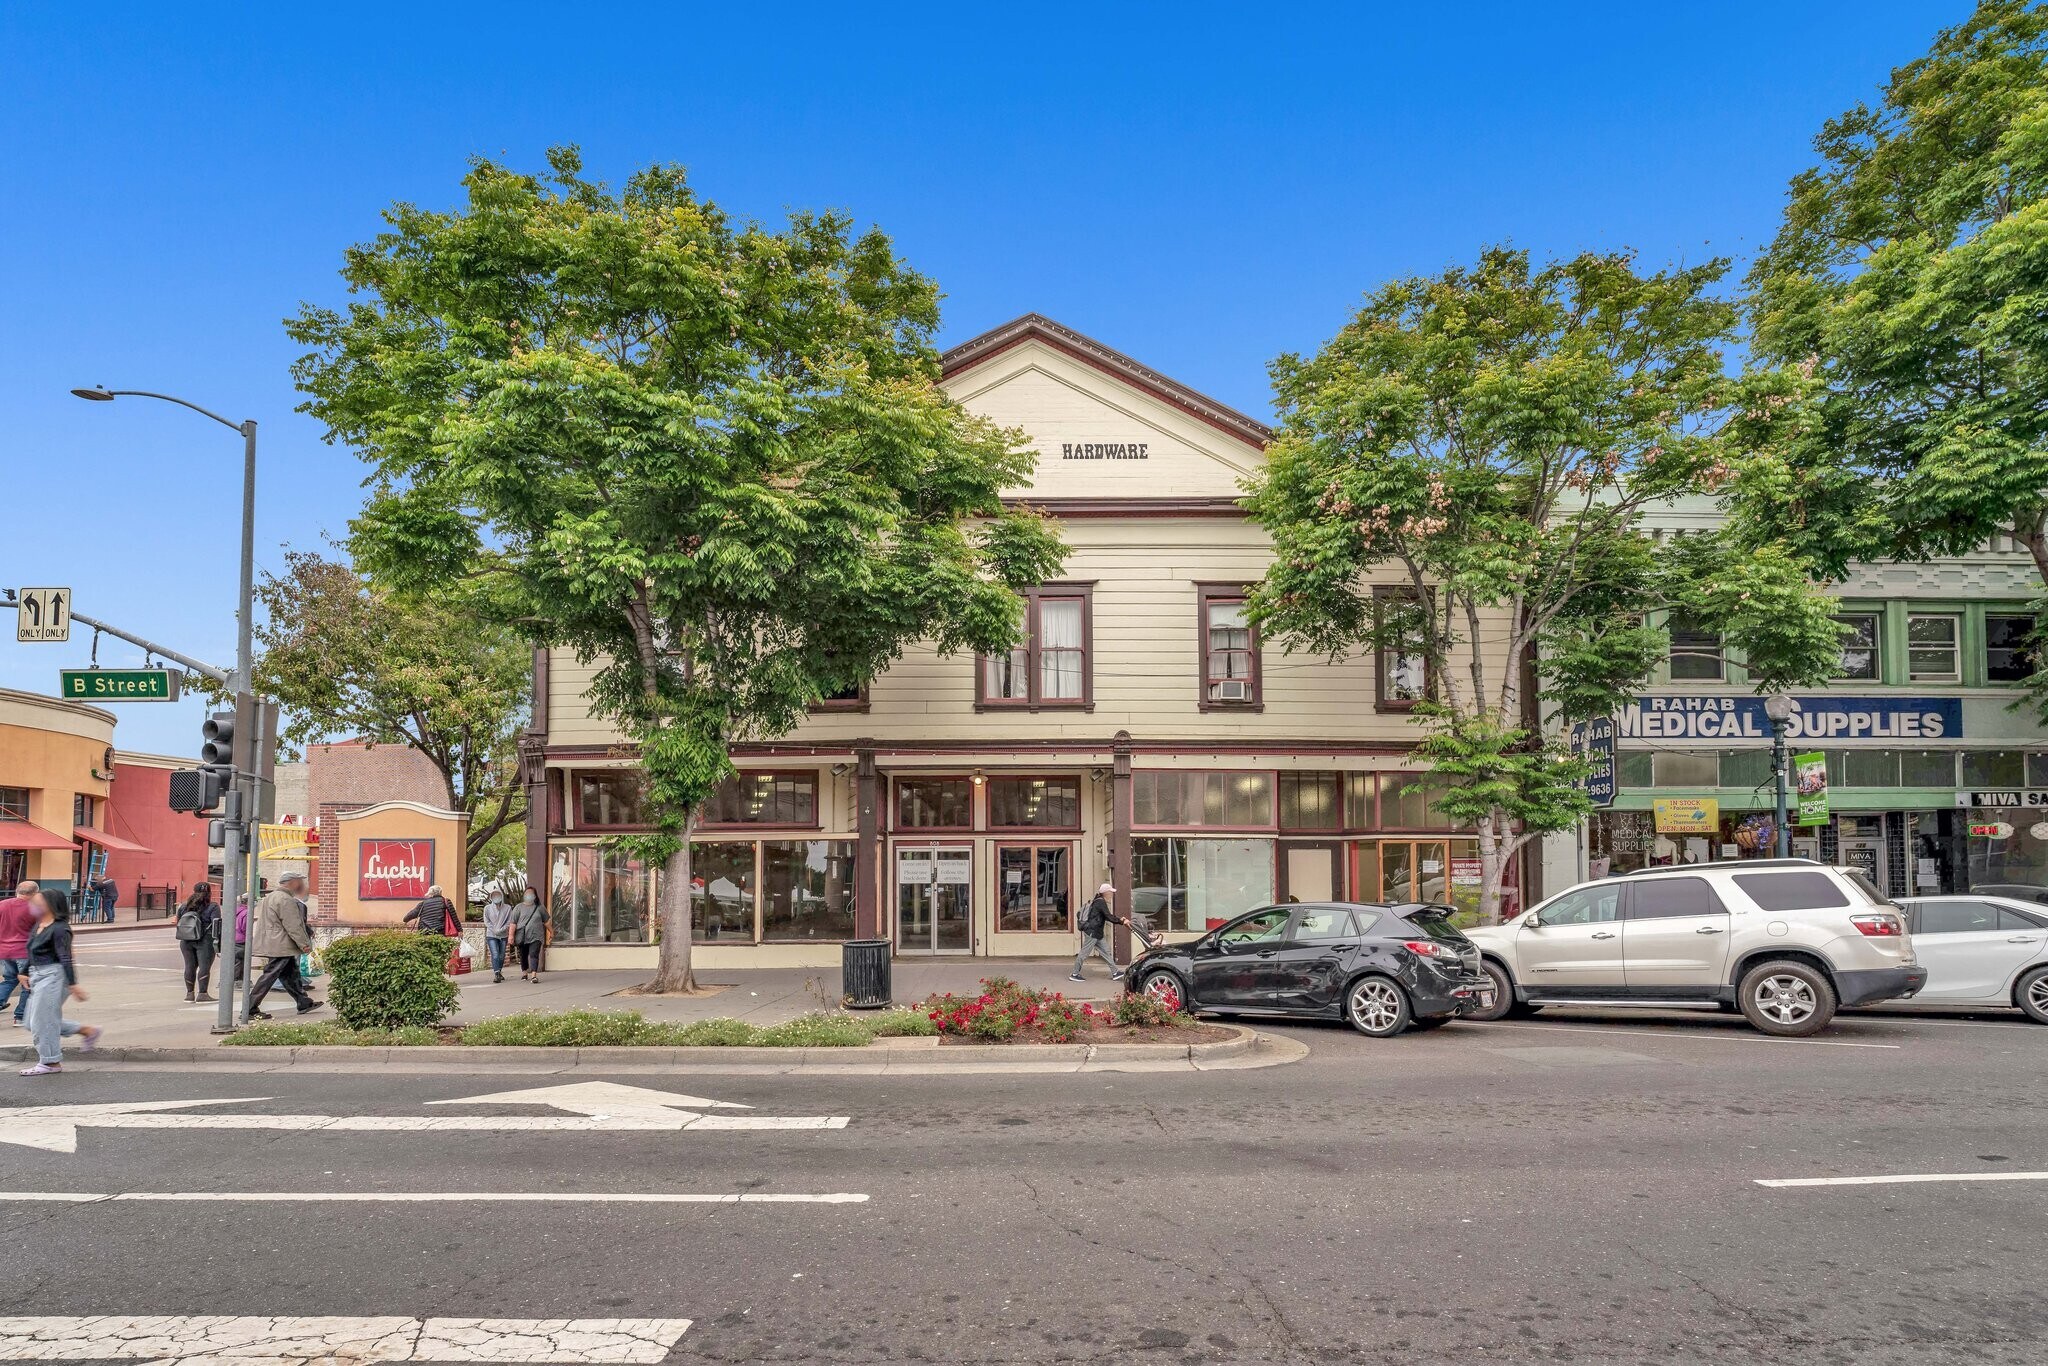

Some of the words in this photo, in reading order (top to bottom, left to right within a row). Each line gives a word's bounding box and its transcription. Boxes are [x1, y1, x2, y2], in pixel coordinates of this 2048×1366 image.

[1062, 443, 1148, 460] HARDWARE
[20, 629, 41, 638] ONLY
[45, 629, 66, 638] ONLY
[73, 678, 86, 693] B
[95, 678, 158, 692] Street
[1651, 698, 1736, 711] RAHAB
[1613, 701, 1763, 737] MEDICAL
[1781, 698, 1944, 738] SUPPLIES
[1979, 793, 2019, 806] MIVA
[1801, 805, 1827, 814] HOME
[1611, 829, 1654, 839] MEDICAL
[1971, 825, 1998, 835] OPEN
[1612, 841, 1655, 851] SUPPLIES
[364, 854, 425, 883] Lucky
